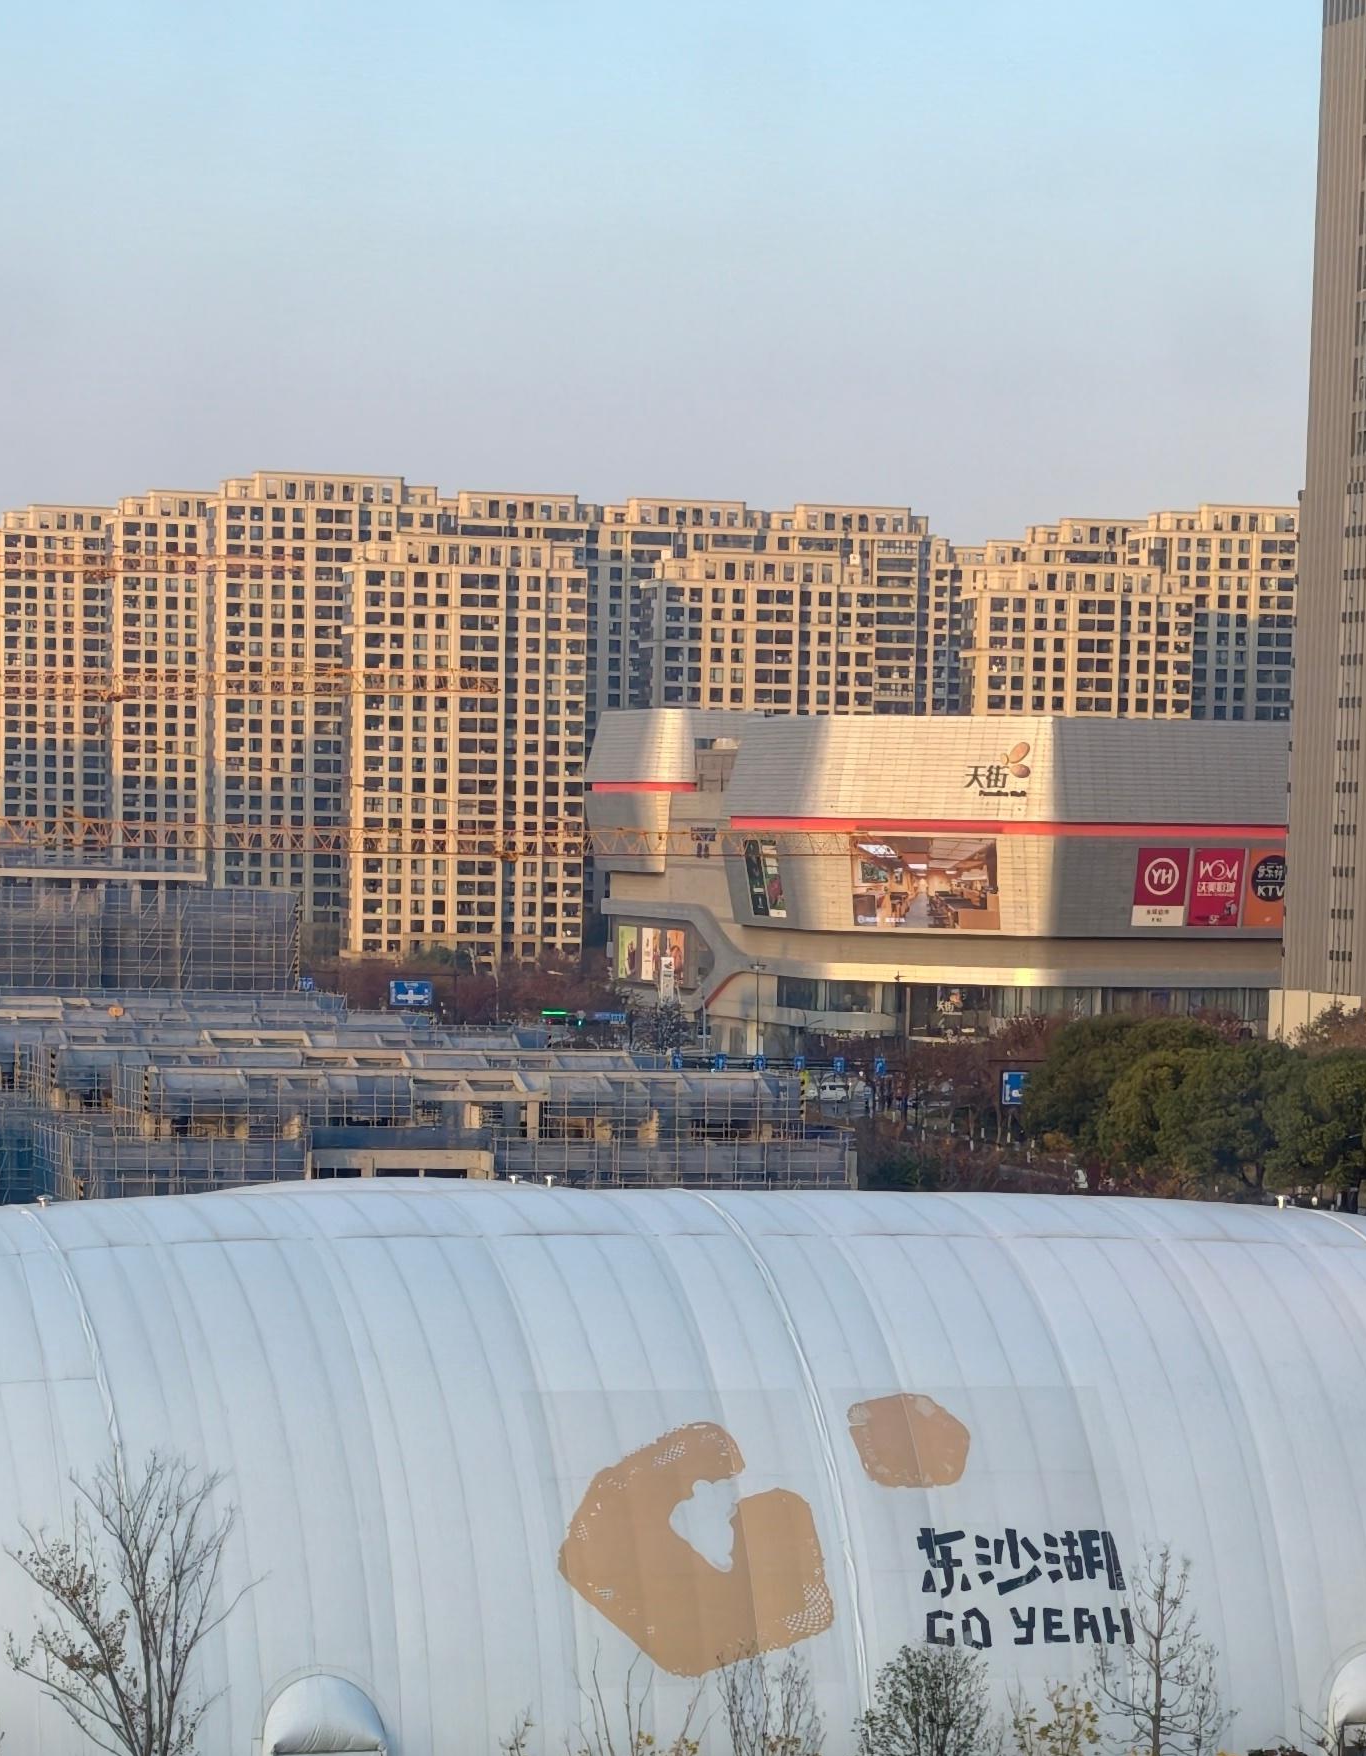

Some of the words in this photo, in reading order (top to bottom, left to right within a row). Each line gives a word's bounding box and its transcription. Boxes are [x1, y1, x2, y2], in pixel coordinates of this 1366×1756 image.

[964, 765, 1010, 788] 天街
[1151, 868, 1173, 885] YH
[1257, 885, 1285, 897] KTV
[917, 1527, 1126, 1598] 东沙湖
[926, 1607, 993, 1650] GO
[1009, 1607, 1135, 1645] YEAH
